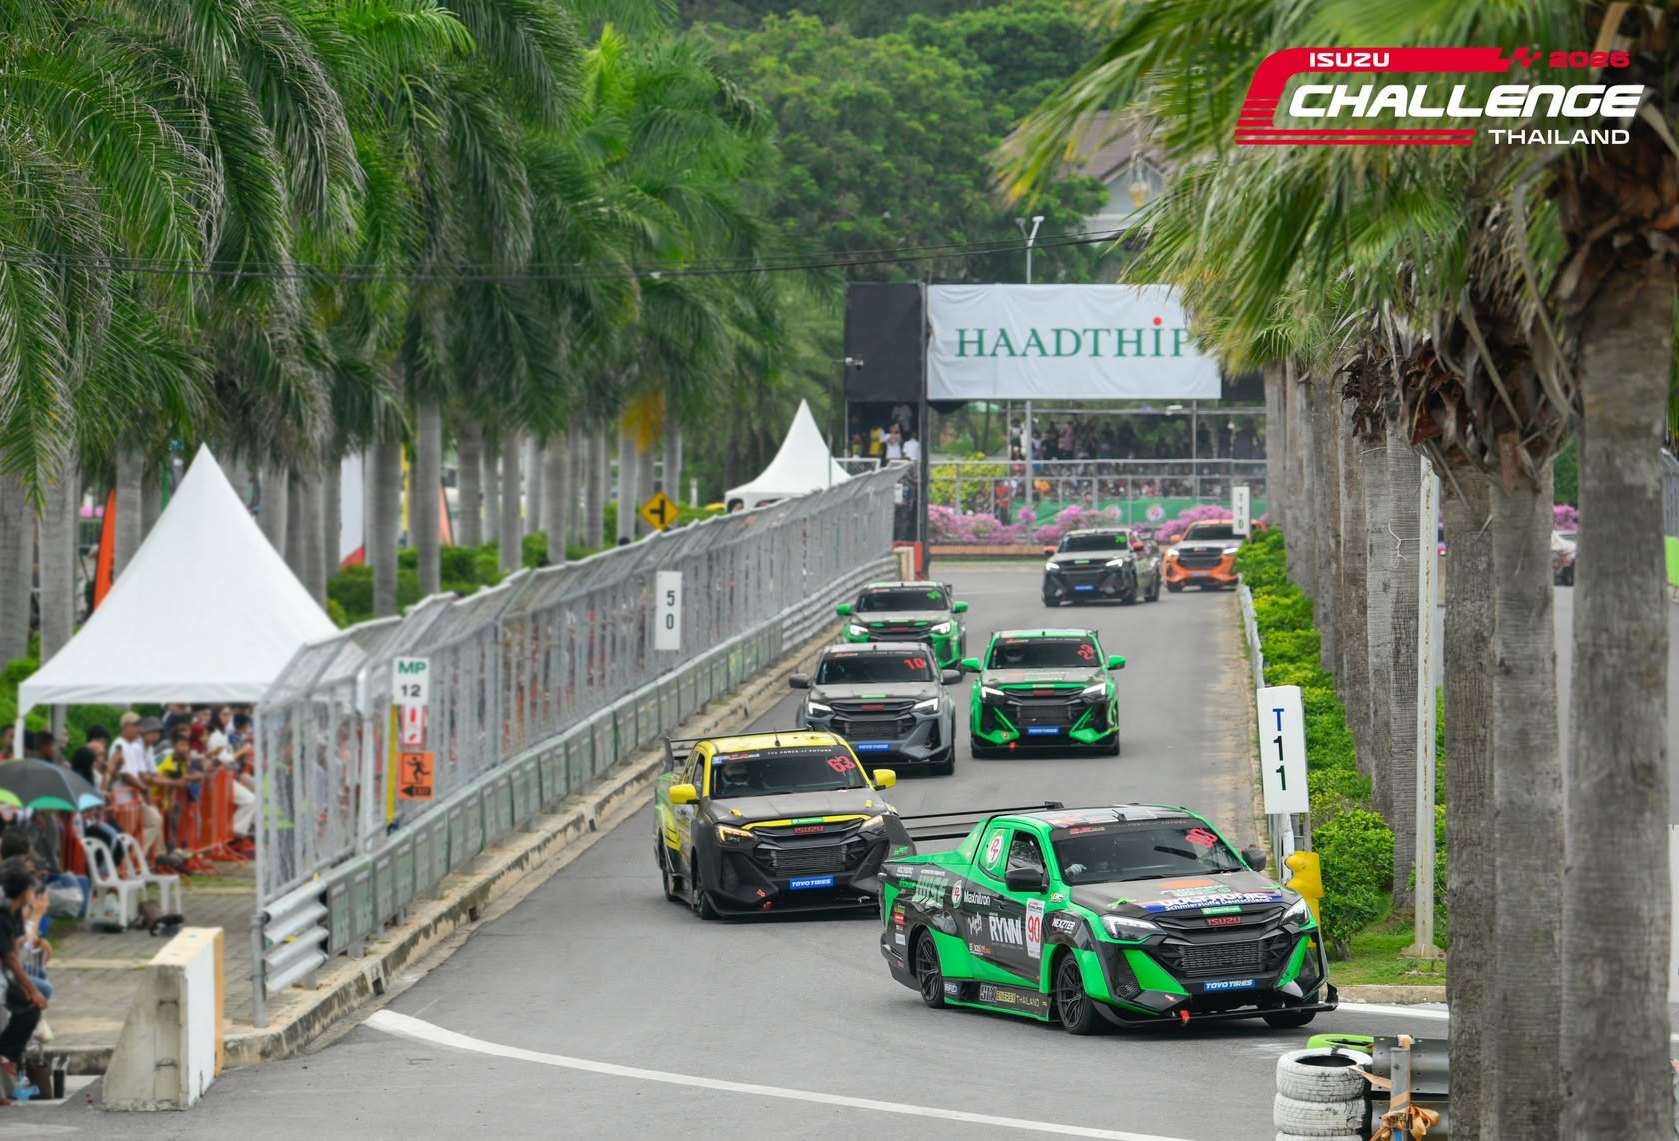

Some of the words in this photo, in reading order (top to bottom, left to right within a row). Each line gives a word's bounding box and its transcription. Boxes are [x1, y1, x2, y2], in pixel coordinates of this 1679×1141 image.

[665, 590, 676, 630] 50
[398, 661, 427, 675] MP
[904, 657, 927, 670] 10
[400, 684, 421, 698] 12
[1272, 707, 1287, 791] T11
[827, 755, 856, 773] 63
[793, 825, 824, 833] ISUZU
[1185, 828, 1218, 849] 90
[1207, 916, 1242, 926] ISUZU
[1028, 915, 1041, 944] 90
[1229, 979, 1253, 987] TIRES
